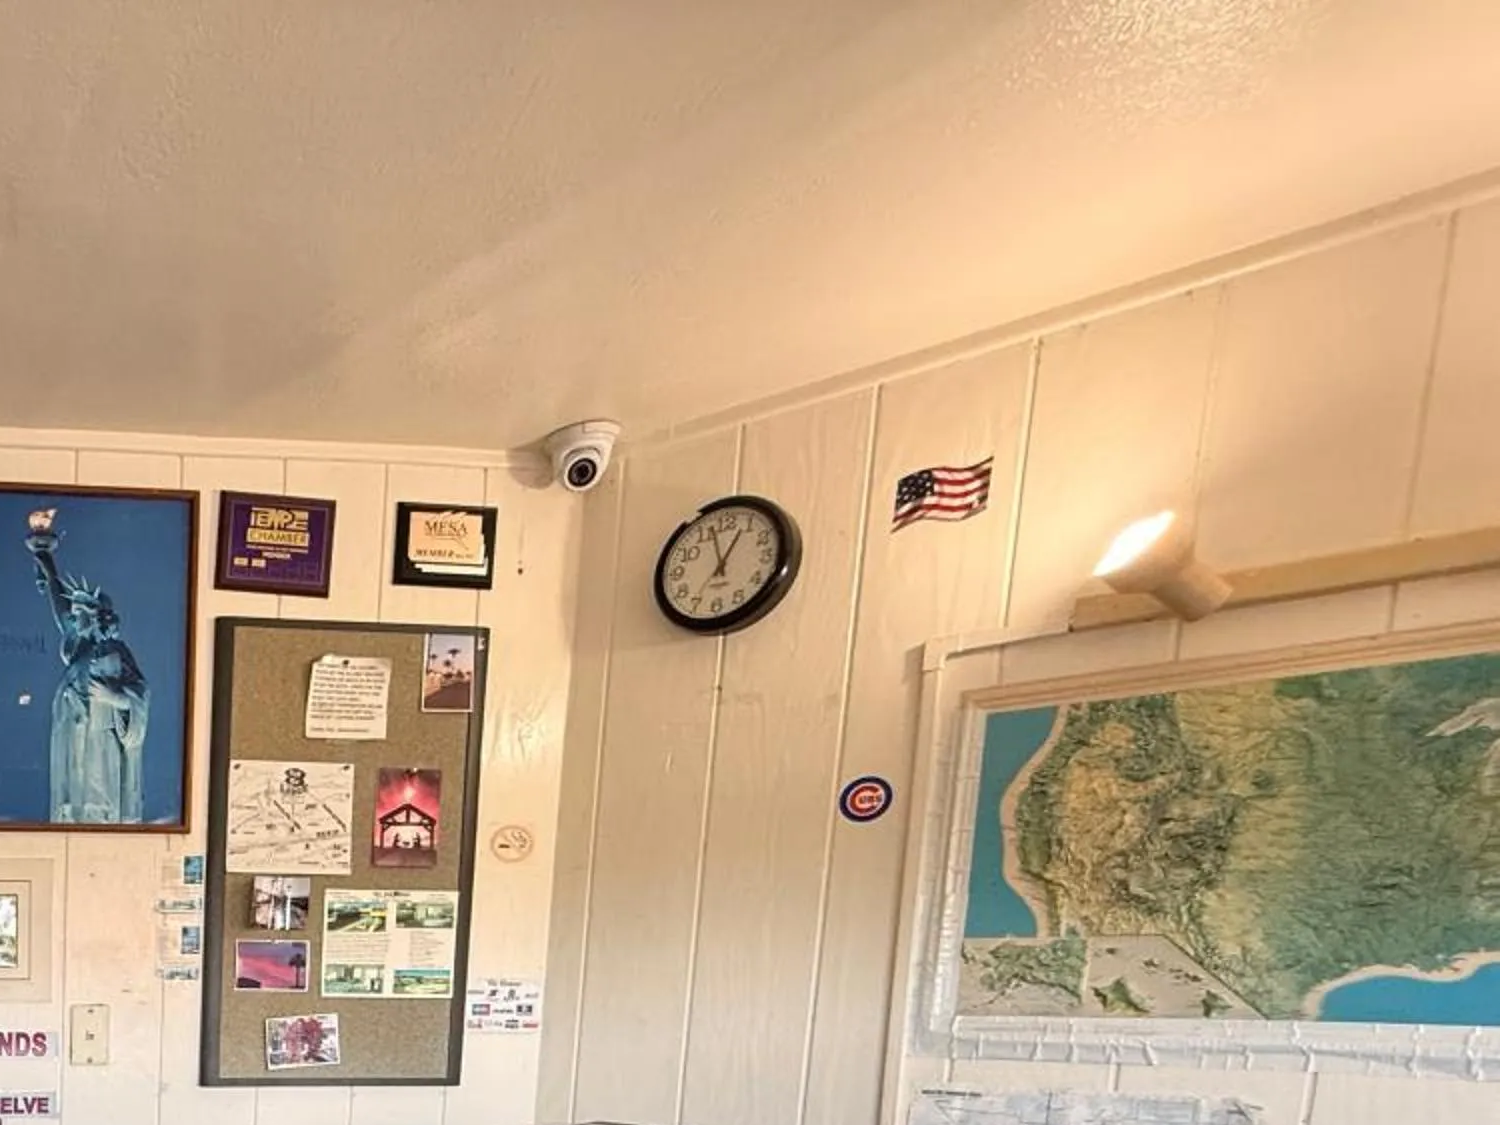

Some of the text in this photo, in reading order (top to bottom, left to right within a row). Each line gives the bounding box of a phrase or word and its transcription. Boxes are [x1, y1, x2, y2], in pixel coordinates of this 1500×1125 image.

[424, 520, 468, 535] MESA
[717, 515, 737, 532] 12
[744, 514, 756, 532] 1
[249, 530, 308, 545] CHAMBER
[680, 546, 700, 563] 10
[671, 566, 685, 581] 9
[691, 597, 702, 613] 7
